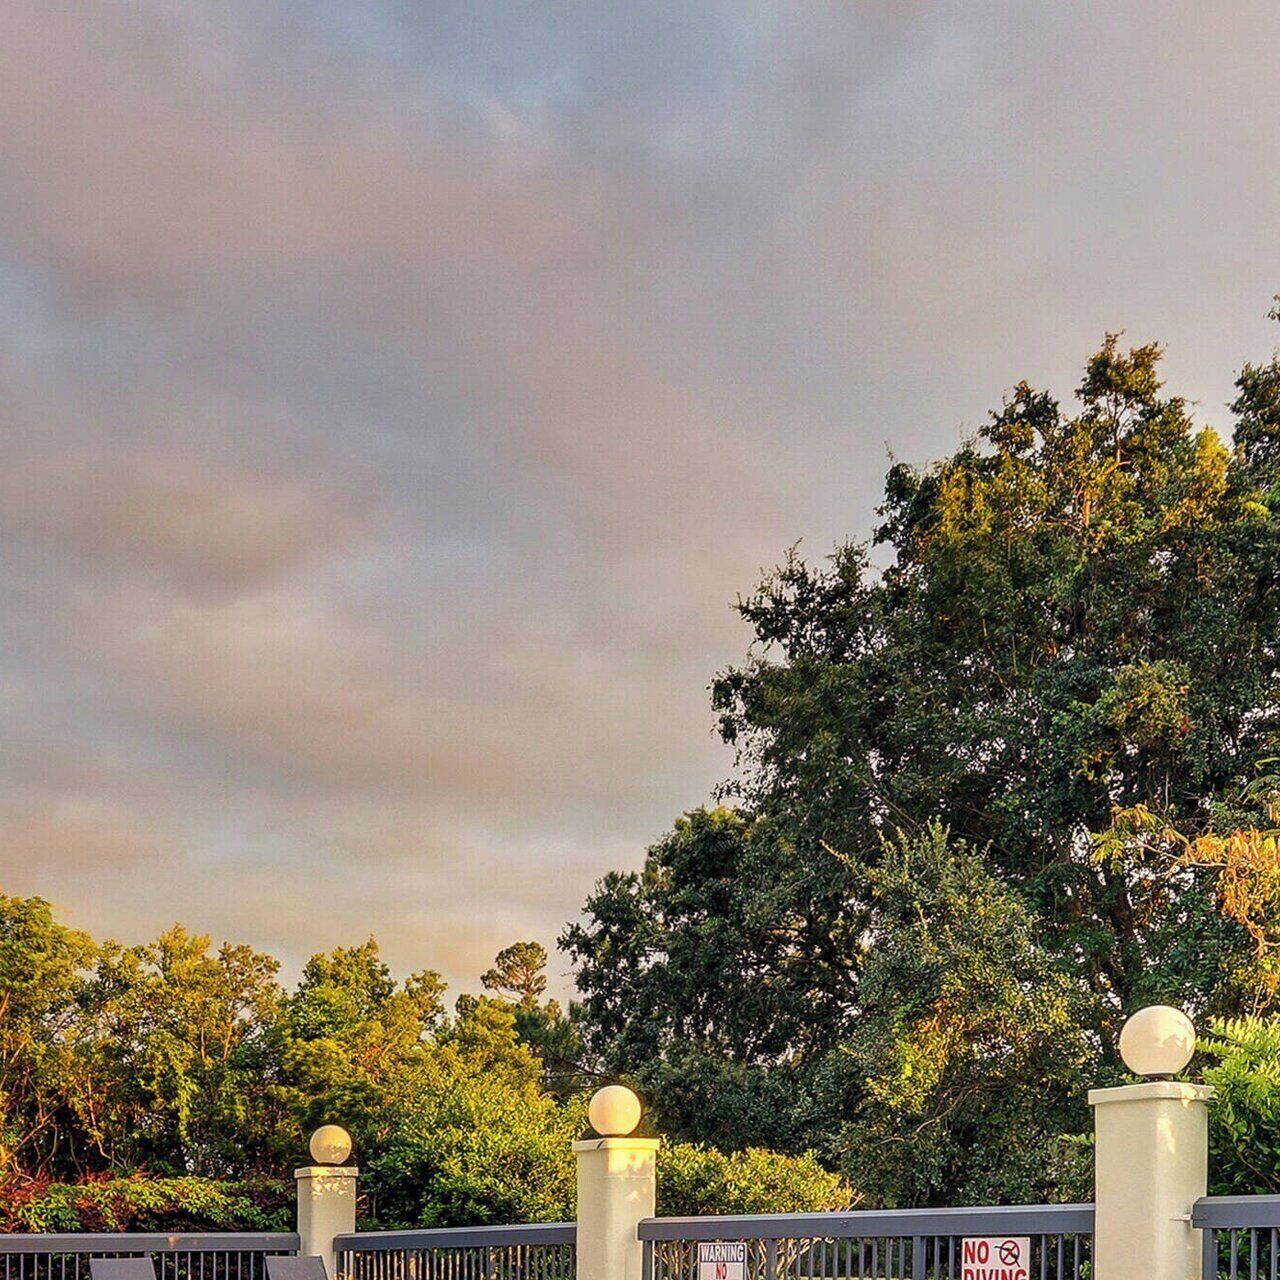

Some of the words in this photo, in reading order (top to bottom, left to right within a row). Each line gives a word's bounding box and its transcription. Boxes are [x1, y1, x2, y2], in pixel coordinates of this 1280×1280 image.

[700, 1245, 744, 1262] WARNING
[964, 1240, 989, 1264] NO
[716, 1263, 727, 1280] NO
